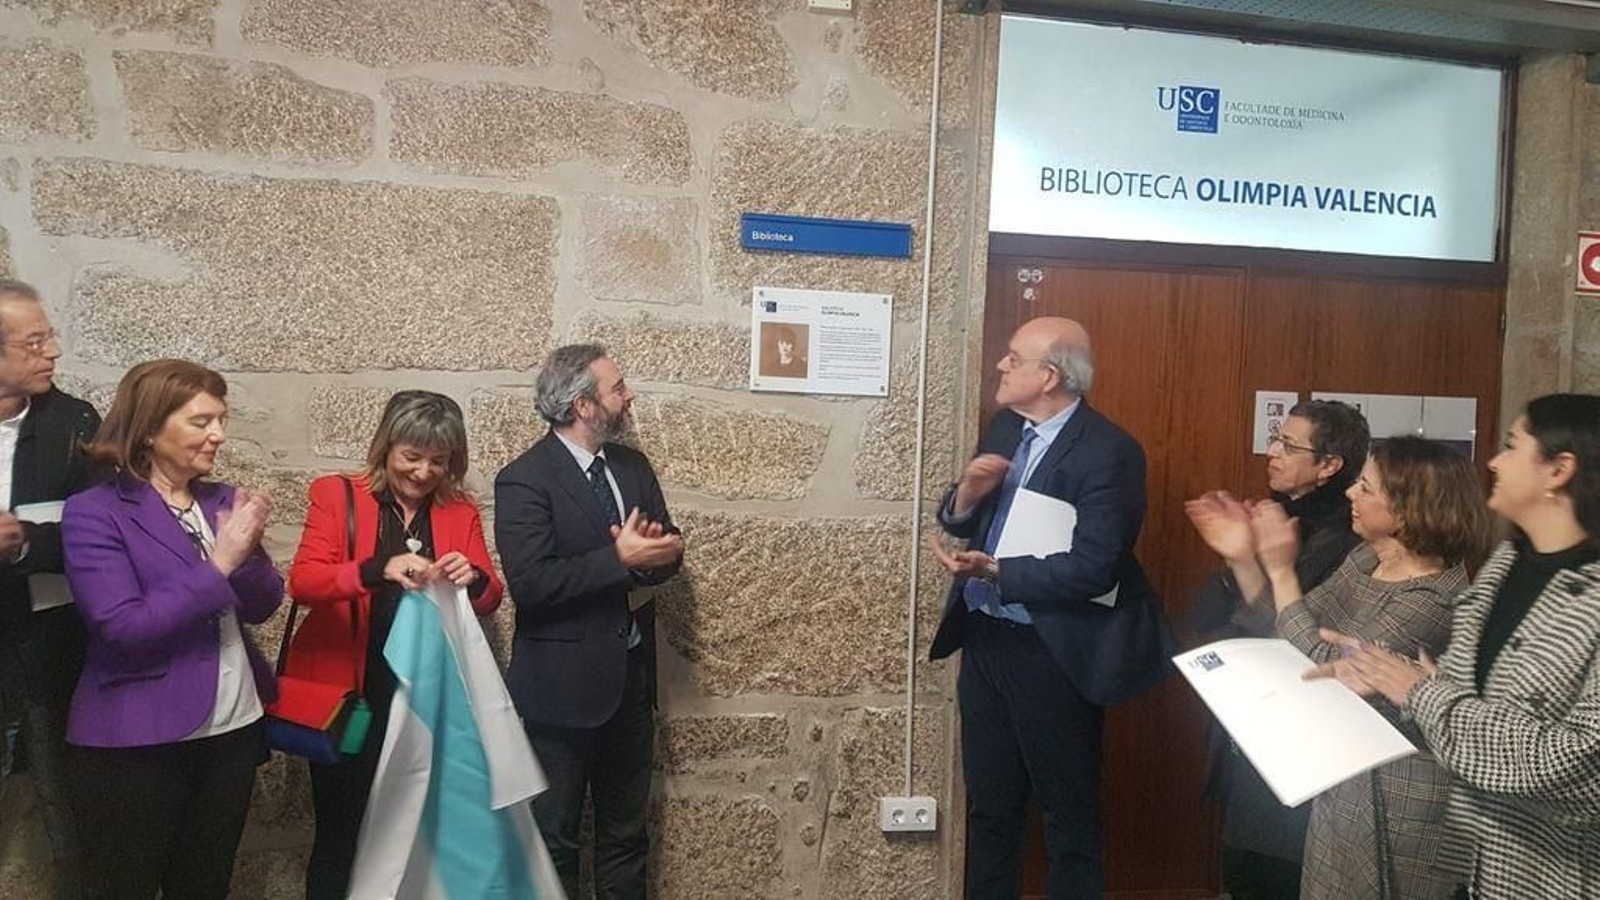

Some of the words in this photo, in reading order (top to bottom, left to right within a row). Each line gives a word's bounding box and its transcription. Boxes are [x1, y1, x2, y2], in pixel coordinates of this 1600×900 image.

[1157, 87, 1215, 114] USC
[1224, 101, 1281, 116] FACULTADE
[1283, 106, 1296, 117] DE
[1298, 108, 1345, 122] MEDICINA
[1224, 114, 1230, 123] E
[1040, 167, 1188, 200] BIBLIOTECA
[1196, 178, 1307, 208] OLIMPIA
[1314, 186, 1438, 219] VALENCIA
[751, 230, 794, 242] Biblioteca
